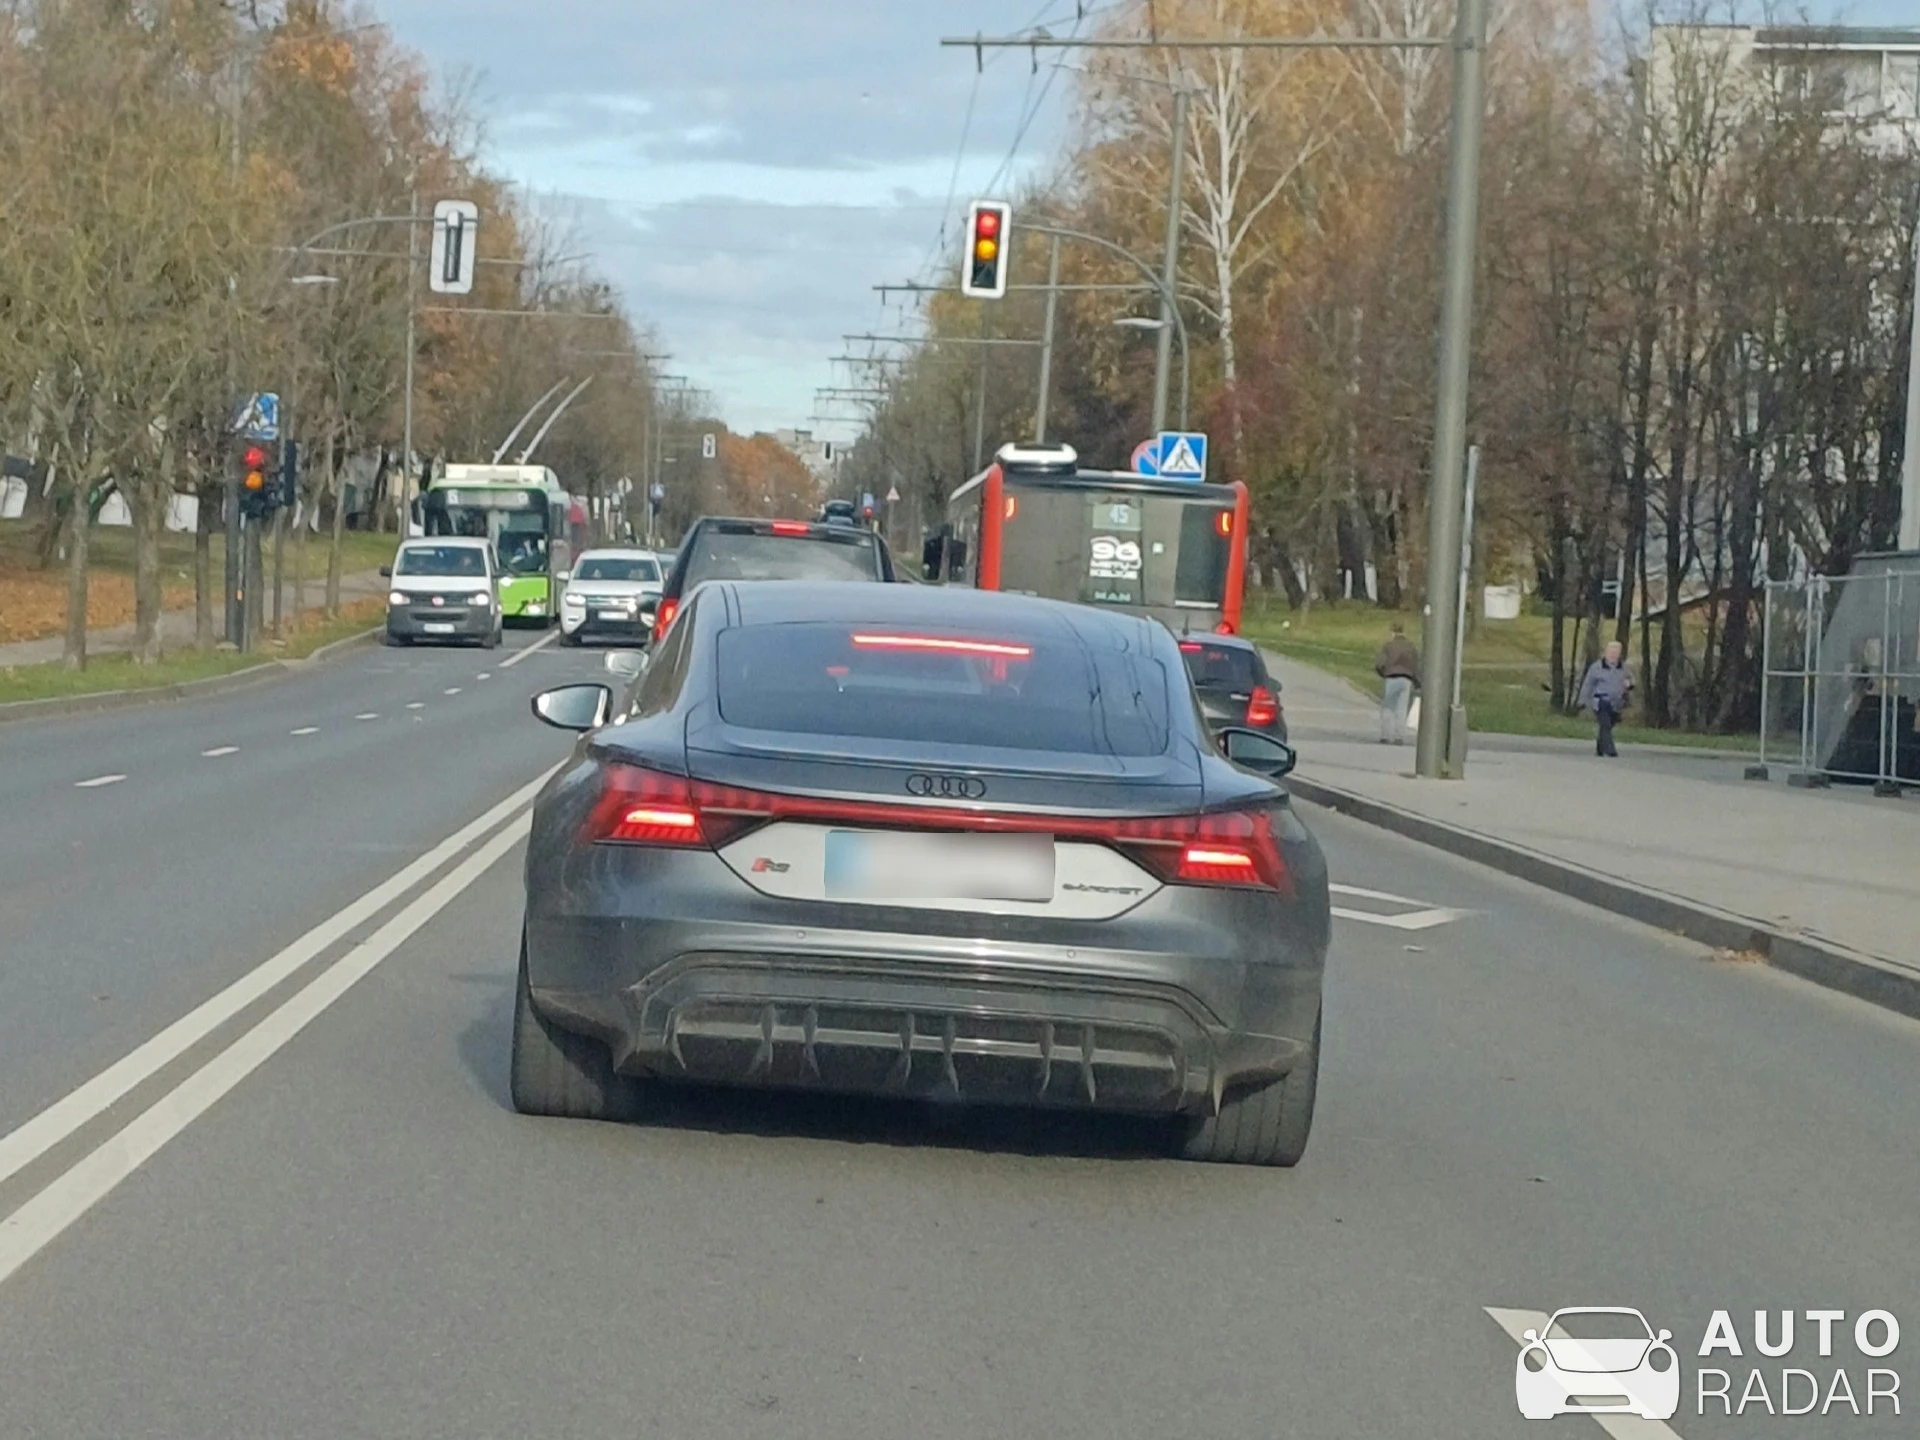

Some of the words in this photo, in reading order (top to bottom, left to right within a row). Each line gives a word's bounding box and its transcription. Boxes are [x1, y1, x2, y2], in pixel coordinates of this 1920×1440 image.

[1109, 504, 1129, 524] 45
[1094, 591, 1131, 602] MAN
[751, 857, 790, 873] RS
